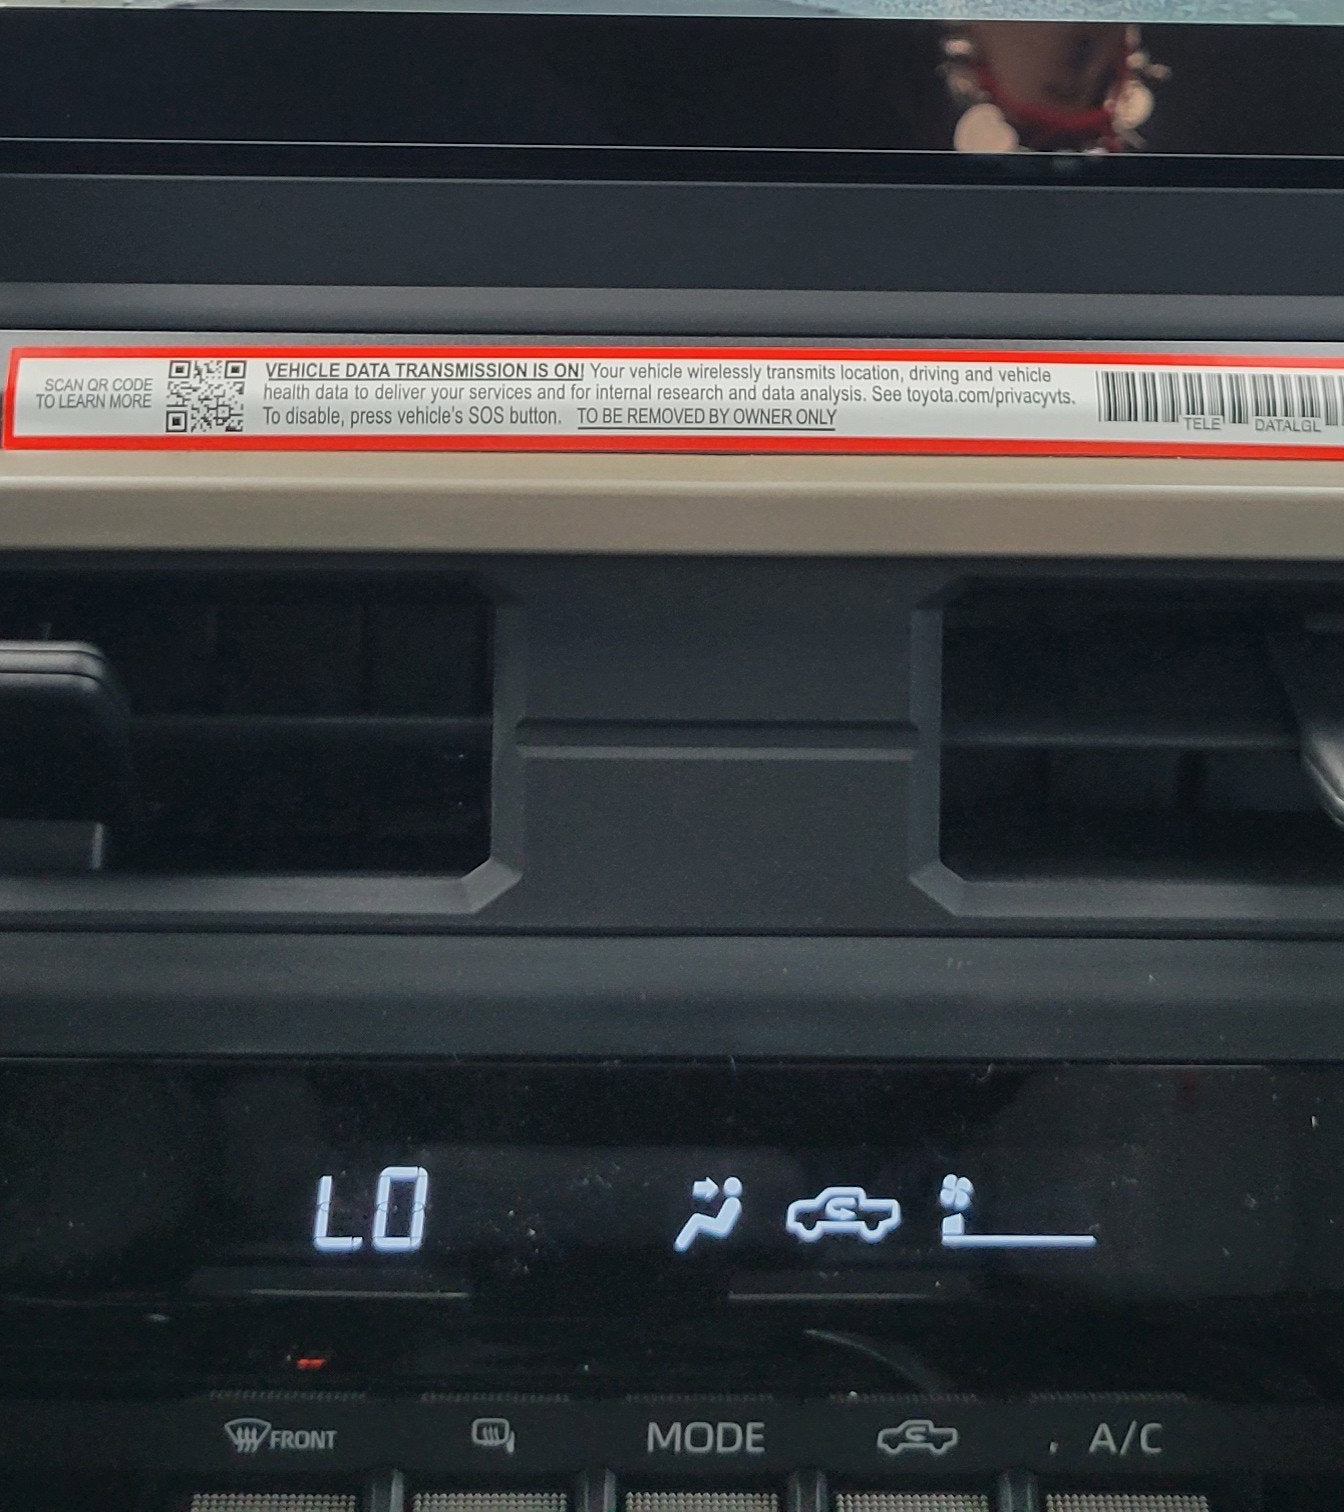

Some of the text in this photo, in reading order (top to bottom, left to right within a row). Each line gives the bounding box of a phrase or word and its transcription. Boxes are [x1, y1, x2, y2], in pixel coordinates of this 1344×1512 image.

[266, 362, 1051, 385] VEHICLE DATA TRANSMISSION IS ON! Your vehicle wirelessly transmits location, driving and vehicle
[45, 378, 154, 392] SCAN QR CODE
[263, 383, 1076, 409] health data to deliver your services and for internal research and data analysis. See toyota.com/privacyvts.
[36, 394, 152, 408] TO LEARN MORE
[263, 406, 837, 428] To disable, press vehicle's SOS button. TO BE REMOVED BY OWNER ONLY
[1183, 417, 1222, 431] TELE
[1255, 418, 1322, 433] DATALGL
[314, 1165, 429, 1251] LO
[269, 1429, 338, 1450] FRONT
[647, 1421, 766, 1454] MODE
[1089, 1421, 1163, 1455] A/C
